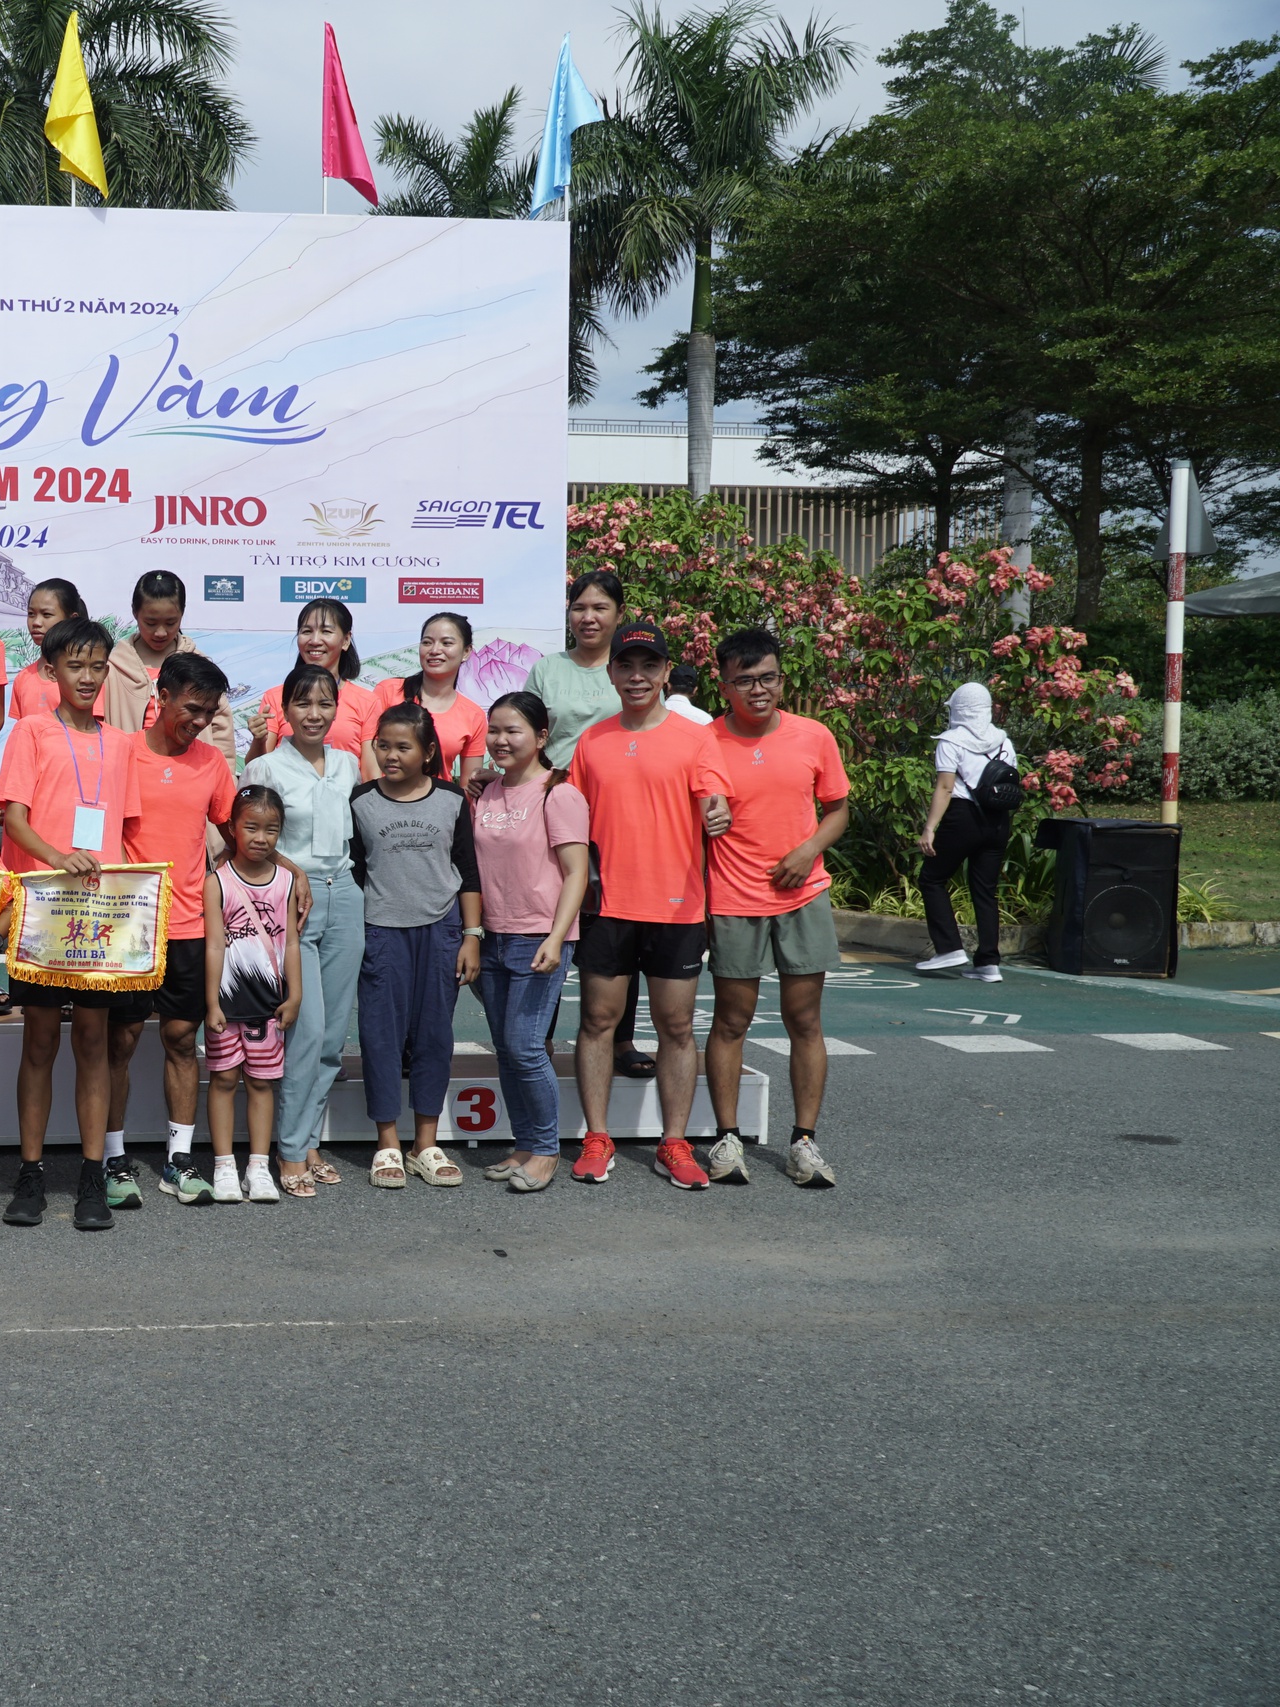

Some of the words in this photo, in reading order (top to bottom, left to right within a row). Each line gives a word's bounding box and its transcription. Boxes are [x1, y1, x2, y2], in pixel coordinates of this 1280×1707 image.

[18, 297, 61, 313] THỨ
[64, 300, 75, 313] 2
[80, 296, 126, 315] NĂM
[130, 302, 180, 316] 2024
[81, 332, 317, 447] Vàm
[33, 466, 132, 503] 2024
[150, 495, 268, 534] JINRO
[326, 507, 362, 519] ZUP
[140, 537, 164, 545] EASY
[165, 537, 178, 545] TO
[179, 537, 211, 547] DRINK,
[211, 538, 241, 546] DRINK
[242, 538, 254, 546] TO
[256, 538, 276, 546] LINK
[249, 553, 281, 566] TÀI
[286, 554, 327, 569] TRỢ
[333, 556, 366, 567] KIM
[371, 555, 441, 568] CƯƠNG
[294, 580, 337, 594] BIDV
[419, 587, 480, 596] AGRIBANK
[378, 820, 410, 838] MARINA
[411, 819, 425, 828] DEL
[426, 822, 441, 836] REY
[90, 949, 106, 959] BA
[456, 1086, 496, 1132] 3
